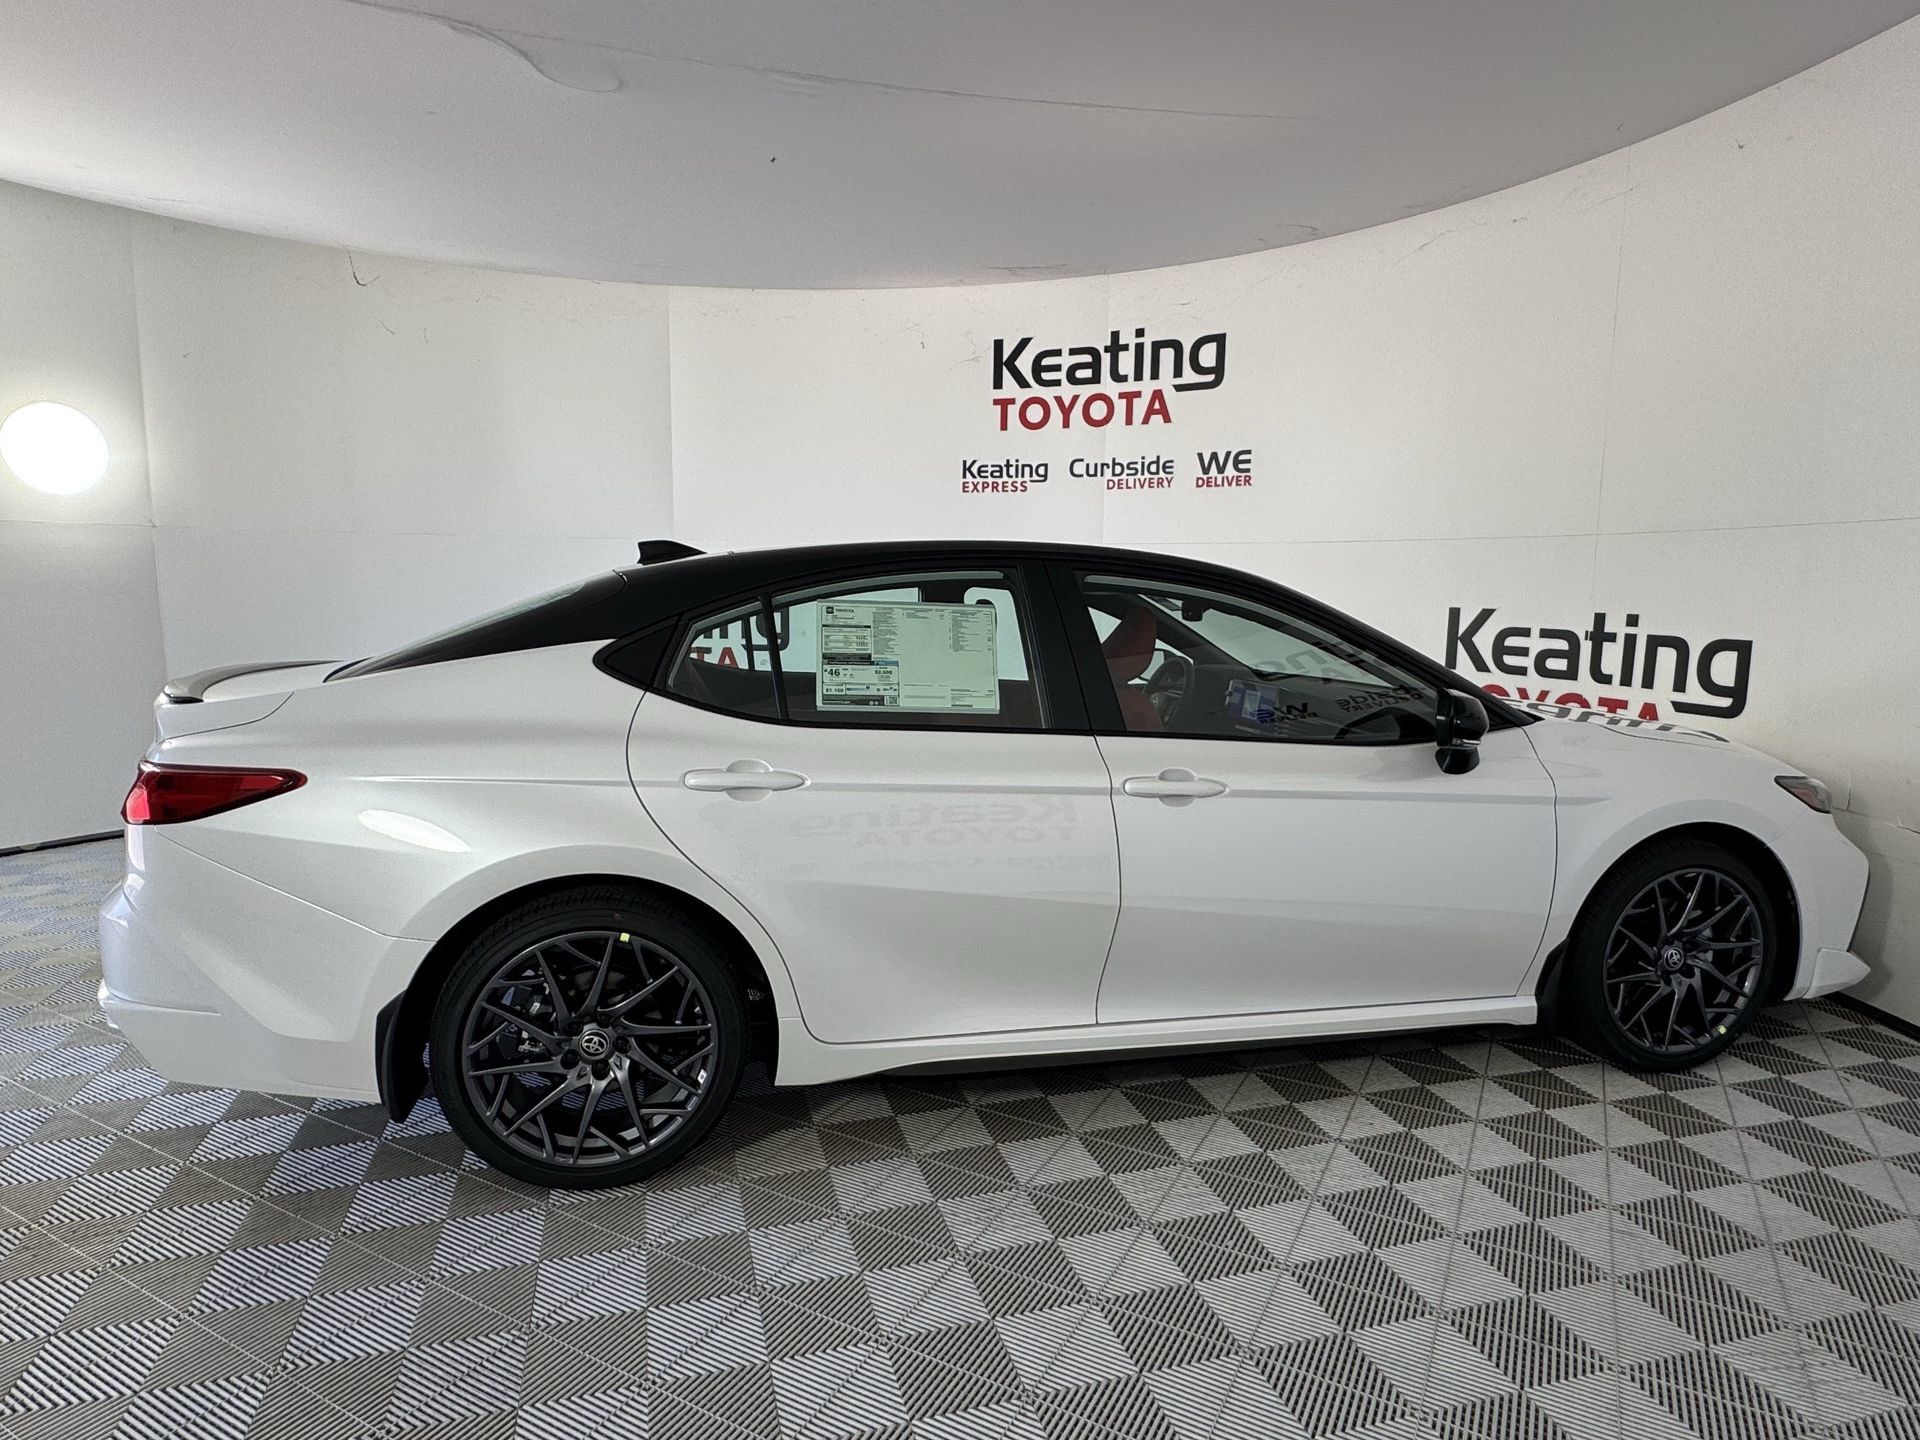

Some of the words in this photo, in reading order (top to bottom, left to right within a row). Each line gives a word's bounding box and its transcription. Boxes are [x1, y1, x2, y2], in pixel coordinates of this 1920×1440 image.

[993, 328, 1227, 392] Keating
[993, 389, 1172, 431] TOYOTA
[962, 458, 1049, 483] Keating
[1069, 455, 1174, 478] Curbside
[1197, 449, 1252, 475] WE
[962, 480, 1028, 493] EXPRESS
[1106, 476, 1174, 490] DELIVERY
[1195, 475, 1252, 488] DELIVER
[828, 668, 841, 676] 46
[1445, 607, 1753, 719] Keating
